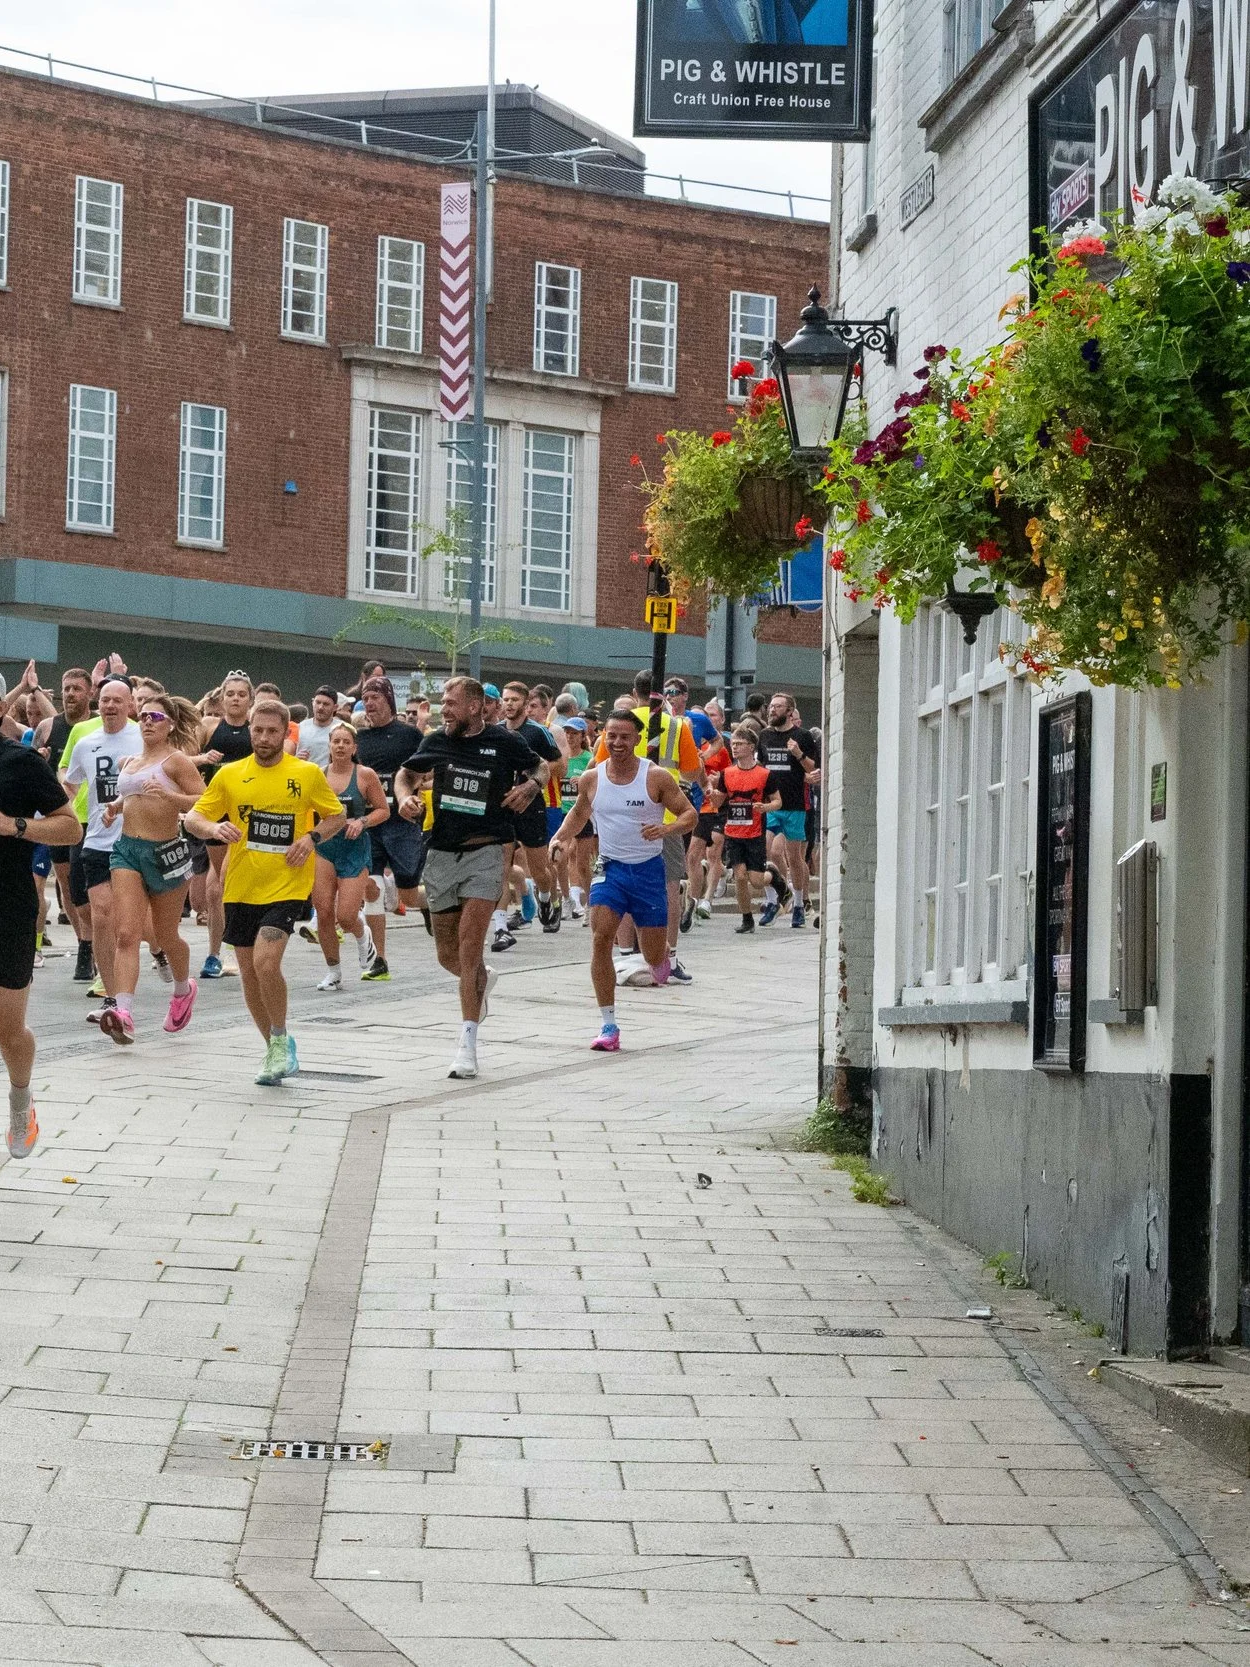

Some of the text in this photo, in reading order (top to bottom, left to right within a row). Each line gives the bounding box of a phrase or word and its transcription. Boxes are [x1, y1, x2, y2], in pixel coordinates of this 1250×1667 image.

[660, 59, 846, 85] PIG & WHISTLE
[673, 92, 831, 108] Craft Union Free House
[1095, 33, 1155, 228] PIG
[1062, 174, 1087, 215] SPORTS
[253, 822, 290, 838] 1805
[161, 846, 190, 866] 1094
